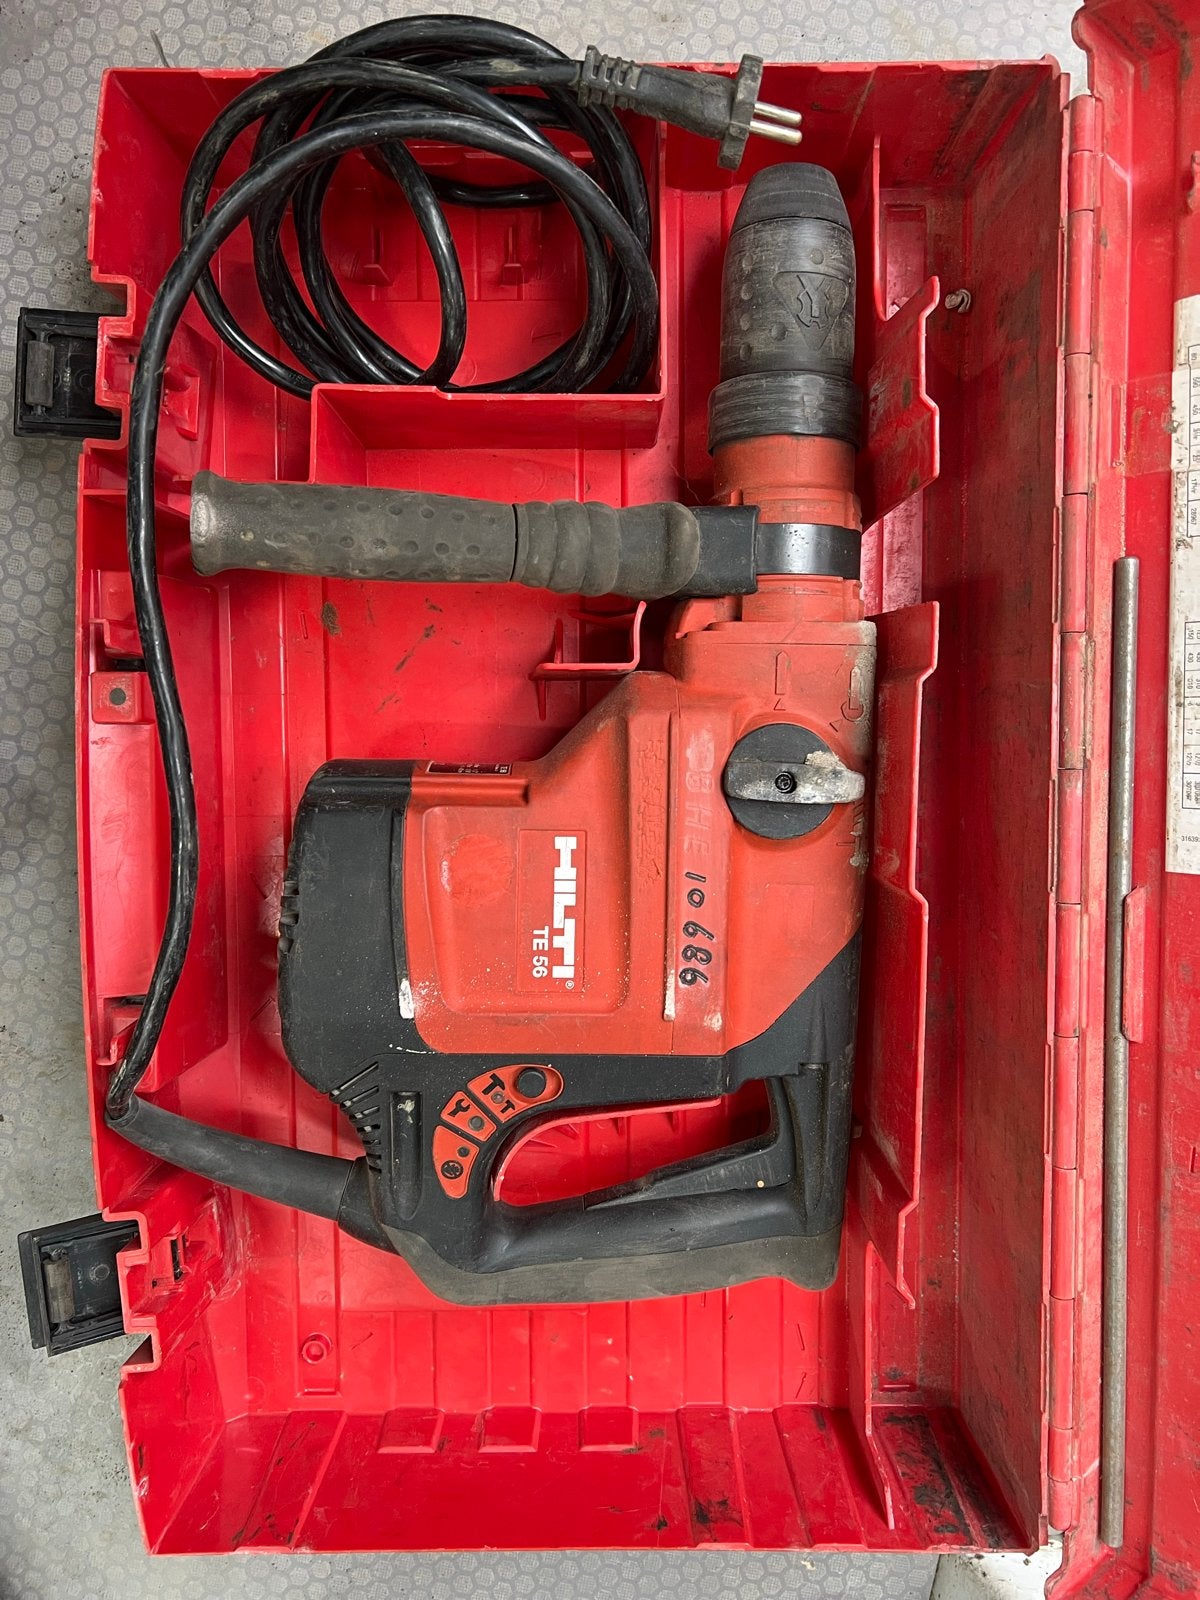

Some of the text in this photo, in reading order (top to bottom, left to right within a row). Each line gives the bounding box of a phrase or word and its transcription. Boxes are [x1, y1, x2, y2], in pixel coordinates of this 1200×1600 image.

[532, 925, 550, 978] TE 56
[552, 836, 577, 979] HILTI
[678, 871, 715, 988] 10 686
